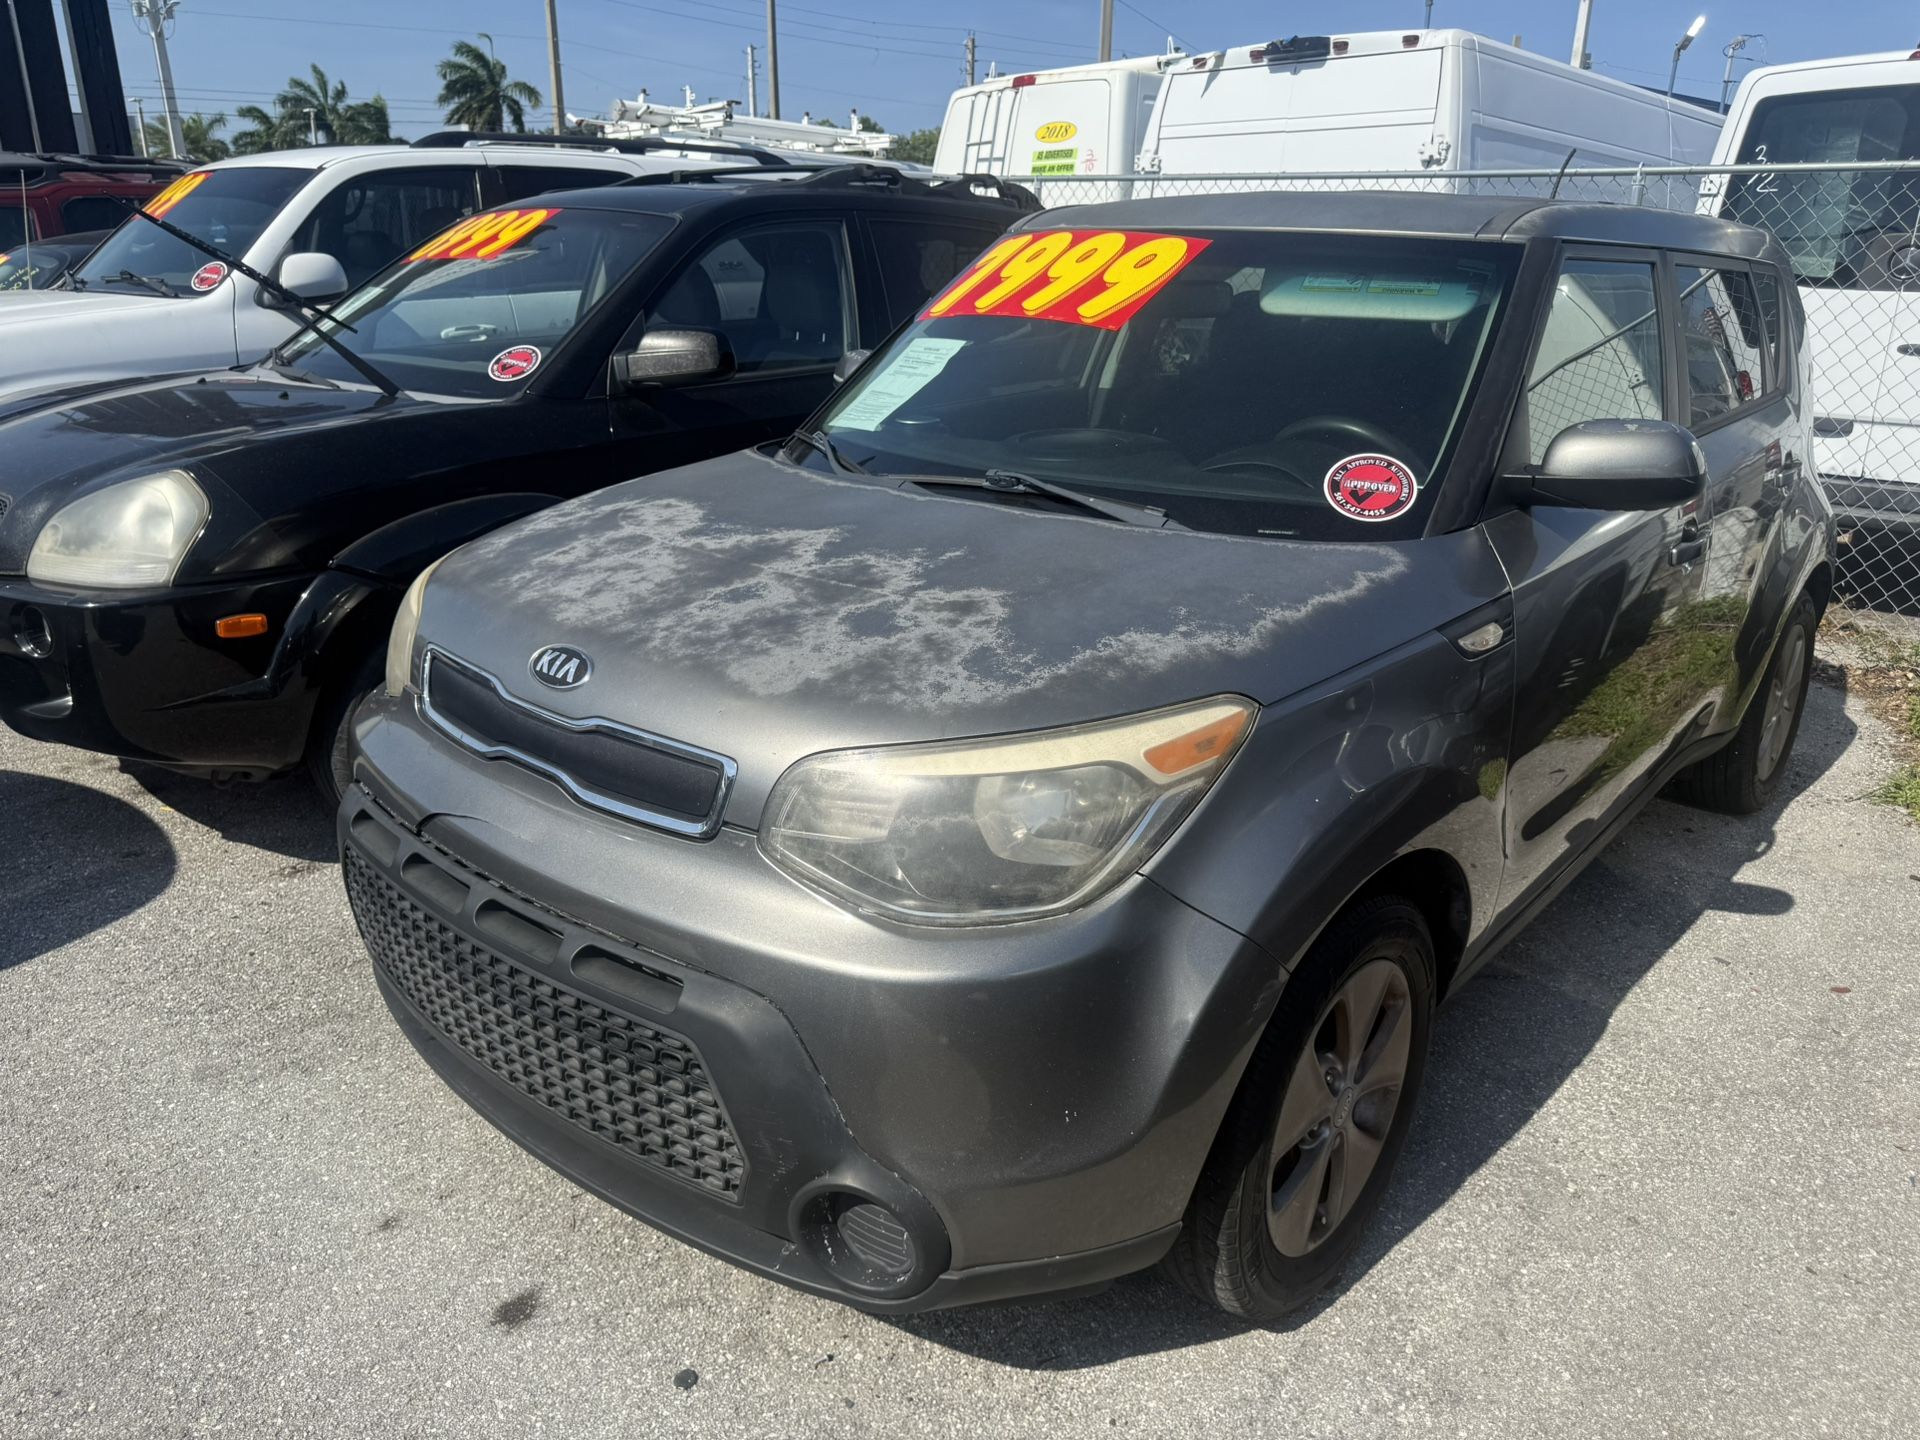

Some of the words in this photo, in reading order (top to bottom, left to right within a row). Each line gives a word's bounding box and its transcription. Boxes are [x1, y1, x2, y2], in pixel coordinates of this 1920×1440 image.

[1040, 125, 1071, 139] 2018
[1055, 164, 1074, 172] OFFER
[1333, 468, 1347, 482] ALL
[1346, 459, 1388, 470] APPROVED
[1343, 479, 1398, 494] APPROVED
[1333, 491, 1386, 516] 561-547-4455
[535, 649, 580, 683] KIA
